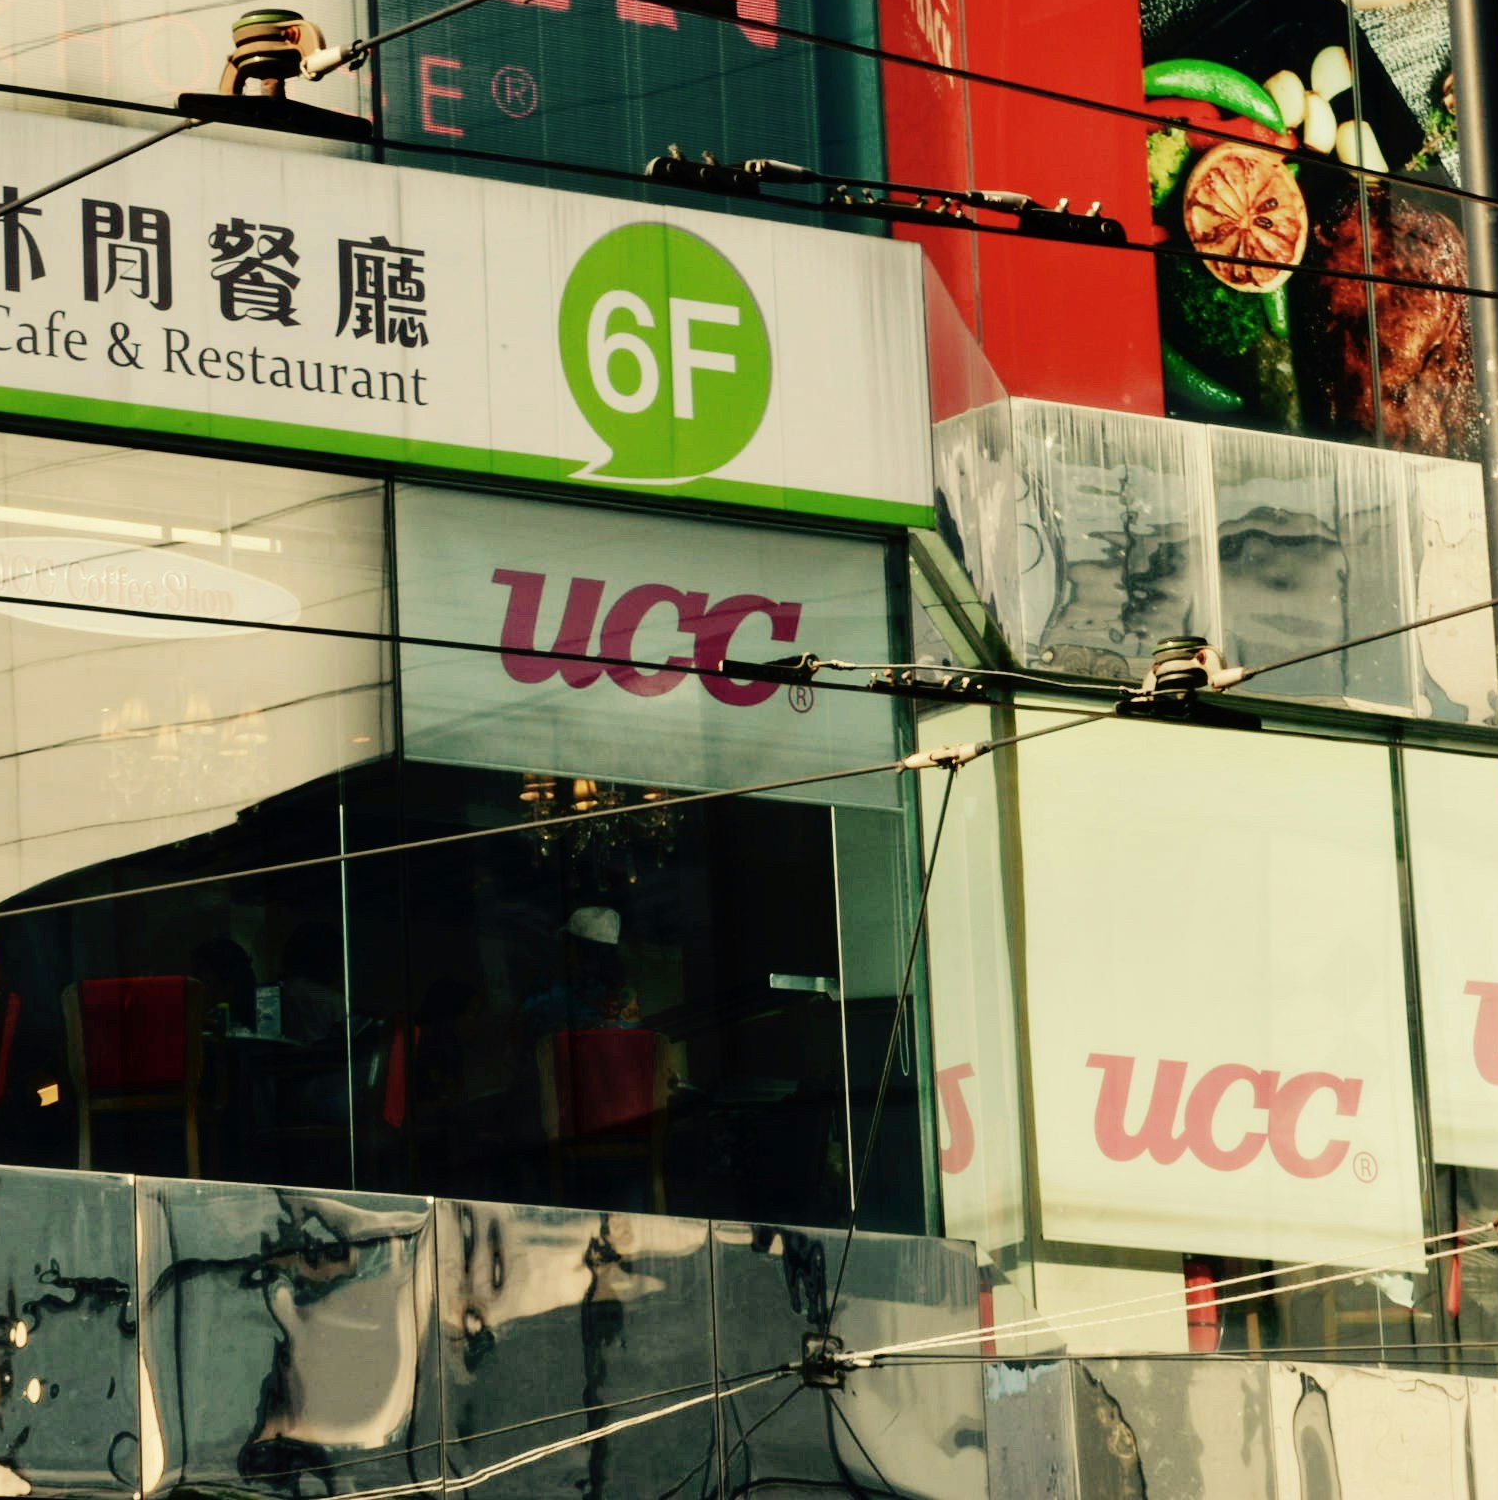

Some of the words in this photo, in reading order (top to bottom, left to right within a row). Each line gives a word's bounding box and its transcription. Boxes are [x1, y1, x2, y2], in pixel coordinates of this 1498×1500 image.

[106, 321, 145, 371] &
[163, 327, 429, 407] Restaurant
[586, 288, 741, 421] 6F
[63, 559, 158, 609] Coffee
[161, 570, 237, 618] Shop
